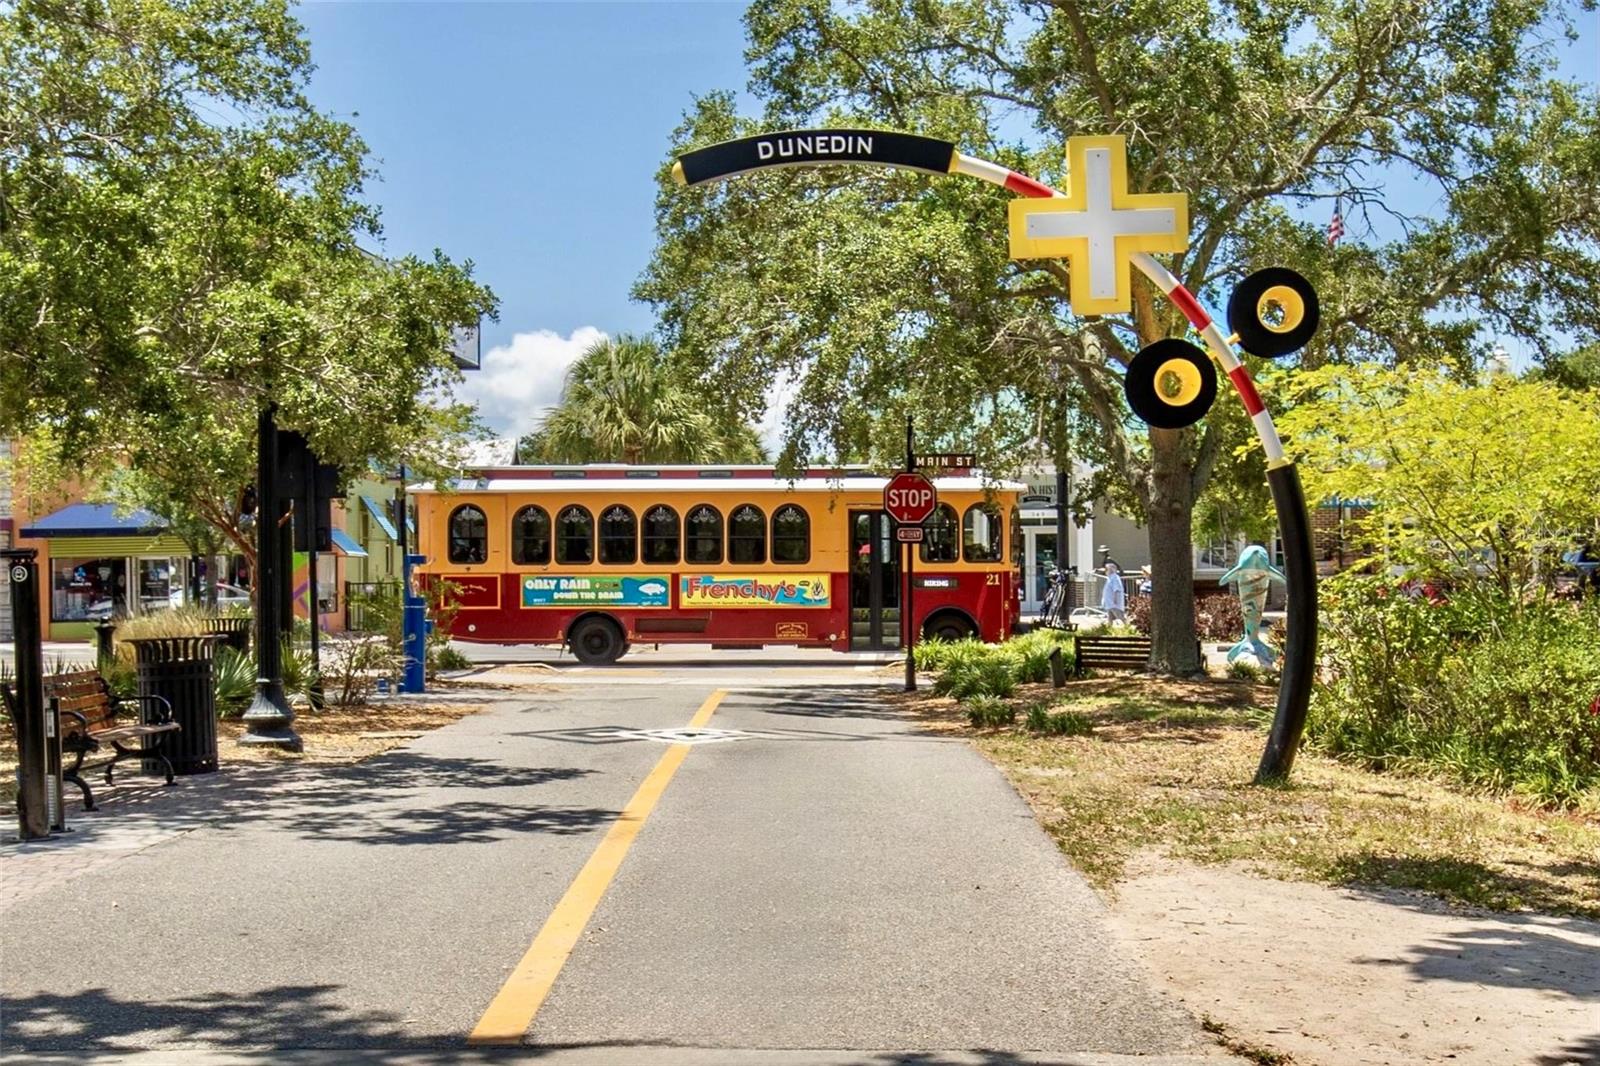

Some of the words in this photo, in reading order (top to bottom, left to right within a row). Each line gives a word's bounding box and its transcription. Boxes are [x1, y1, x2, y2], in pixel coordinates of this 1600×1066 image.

[757, 136, 873, 160] DUNEDIN
[916, 456, 948, 466] MAIN
[956, 456, 972, 466] ST
[888, 489, 932, 508] STOP
[525, 579, 557, 590] ONLY
[559, 579, 591, 590] RAIN
[986, 573, 1000, 586] 21
[553, 591, 579, 600] DOWN
[580, 591, 597, 600] THE
[598, 591, 624, 600] DRAIN
[686, 577, 798, 601] Frenchy's
